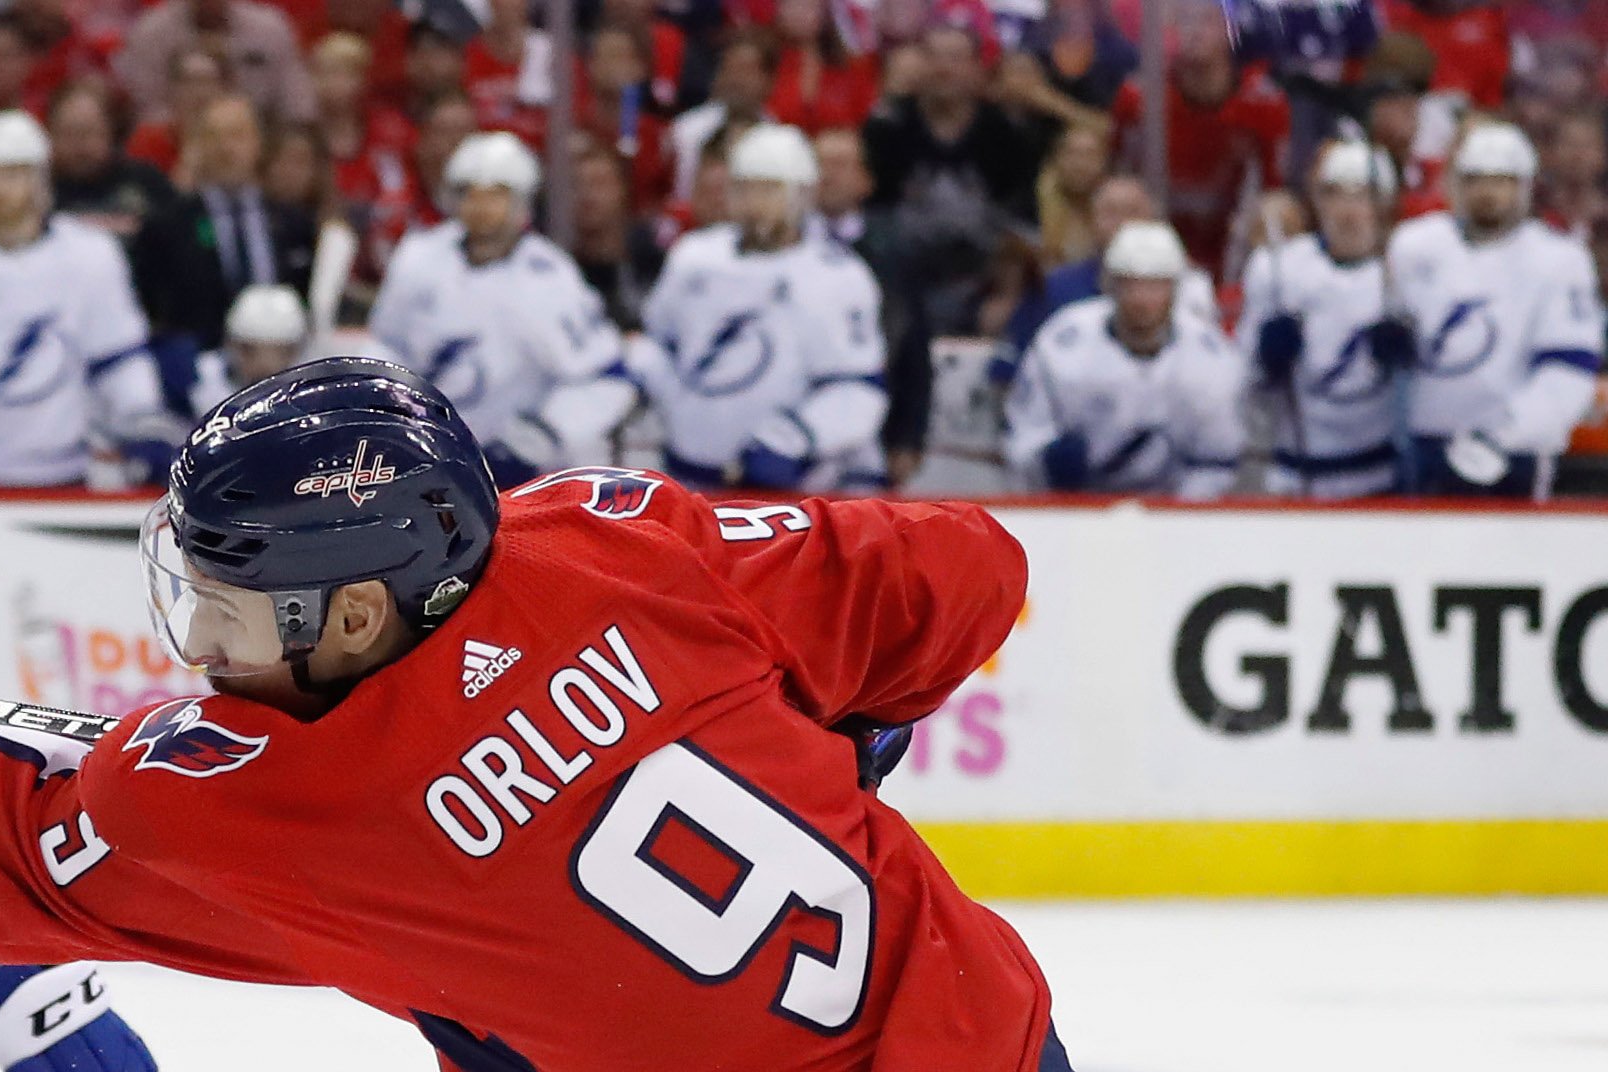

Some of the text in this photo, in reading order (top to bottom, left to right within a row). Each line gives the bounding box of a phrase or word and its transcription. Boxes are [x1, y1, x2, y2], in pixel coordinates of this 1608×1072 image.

[294, 440, 395, 507] capitals
[425, 624, 662, 858] ORLOV
[464, 648, 522, 698] adidas
[569, 739, 874, 1037] 9
